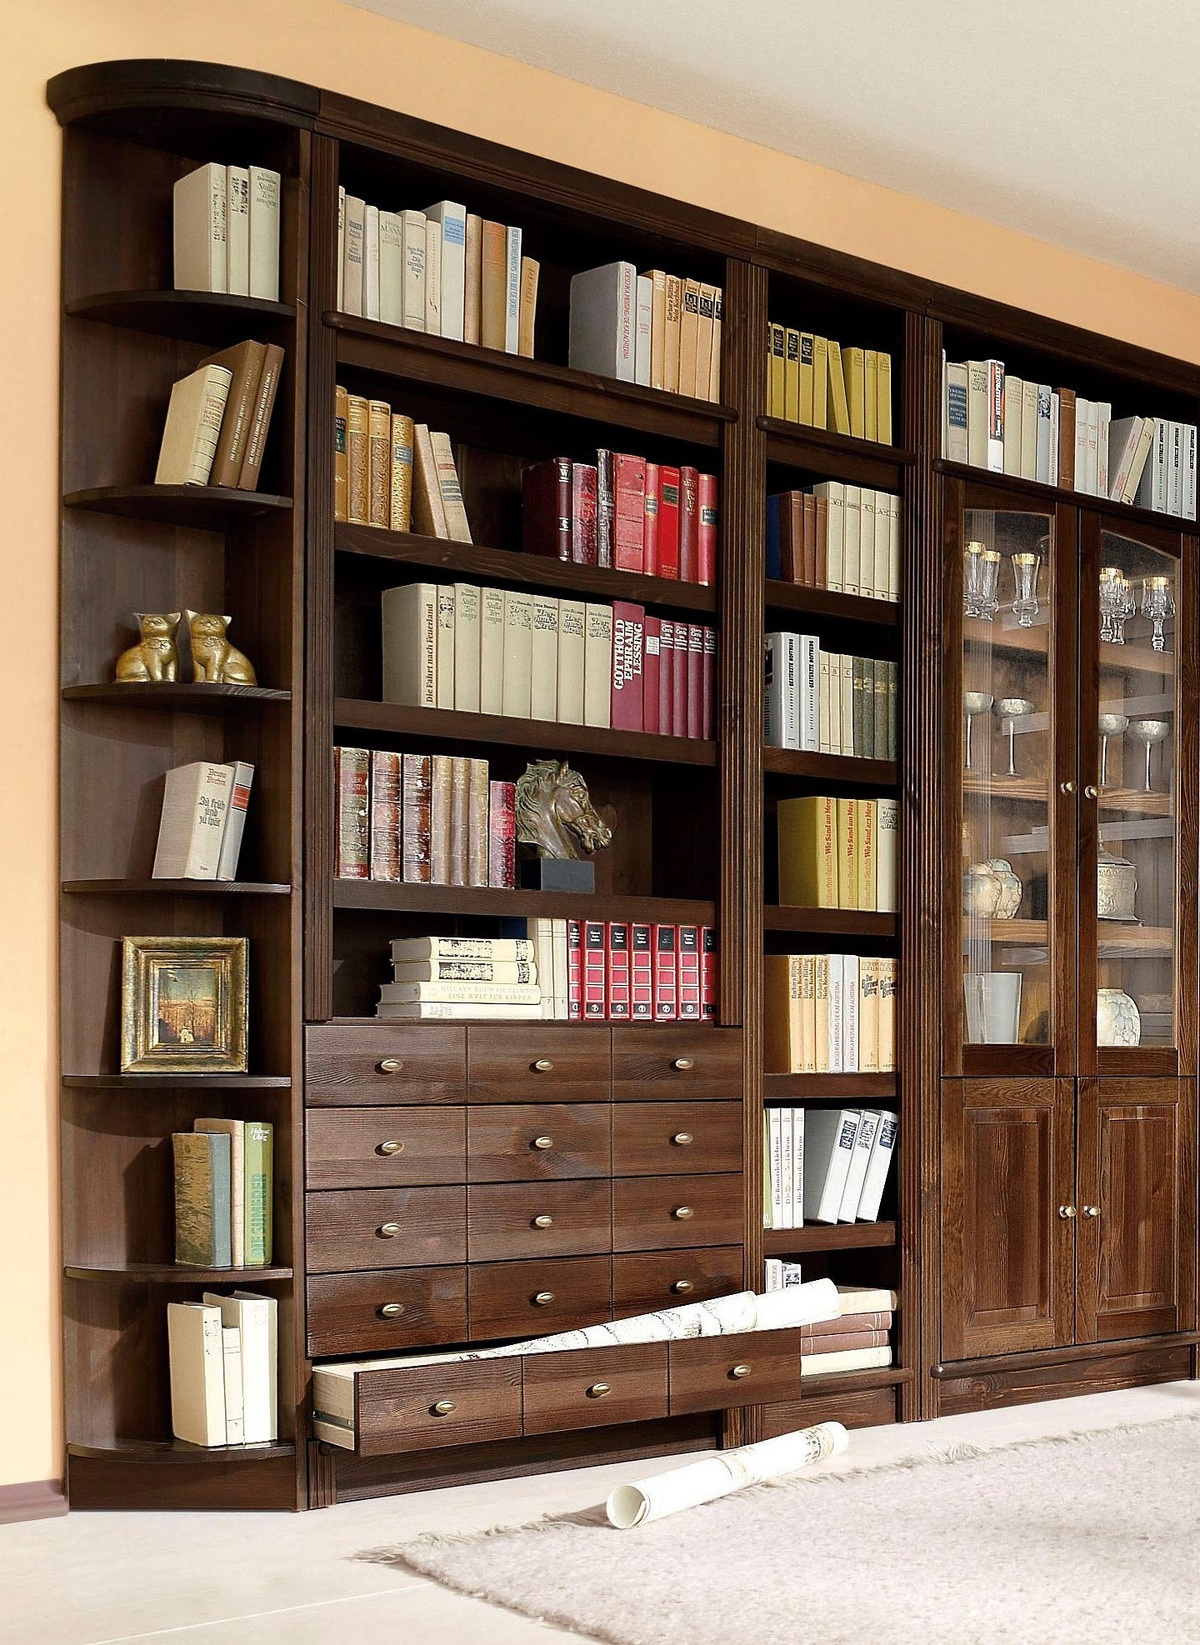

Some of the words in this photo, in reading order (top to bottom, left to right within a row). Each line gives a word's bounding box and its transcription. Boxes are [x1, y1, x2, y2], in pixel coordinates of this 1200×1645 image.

[426, 603, 434, 644] Feuerland
[426, 644, 434, 664] nach
[614, 619, 624, 690] GOTTHOLD
[624, 621, 634, 680] EPHRAIM
[632, 623, 643, 675] LESSING
[426, 665, 434, 689] Fahrt
[426, 688, 434, 703] Die
[206, 776, 226, 786] Brehm
[208, 768, 227, 778] Bruno
[824, 798, 832, 814] Meer
[864, 802, 872, 818] Meer
[824, 814, 832, 825] am
[847, 816, 854, 827] am
[864, 818, 872, 828] am
[824, 824, 832, 842] Sand
[864, 828, 872, 845] Sand
[824, 842, 832, 855] Wie
[864, 844, 872, 858] Wie
[250, 1173, 267, 1235] SUMERER
[250, 1236, 267, 1258] DIE
